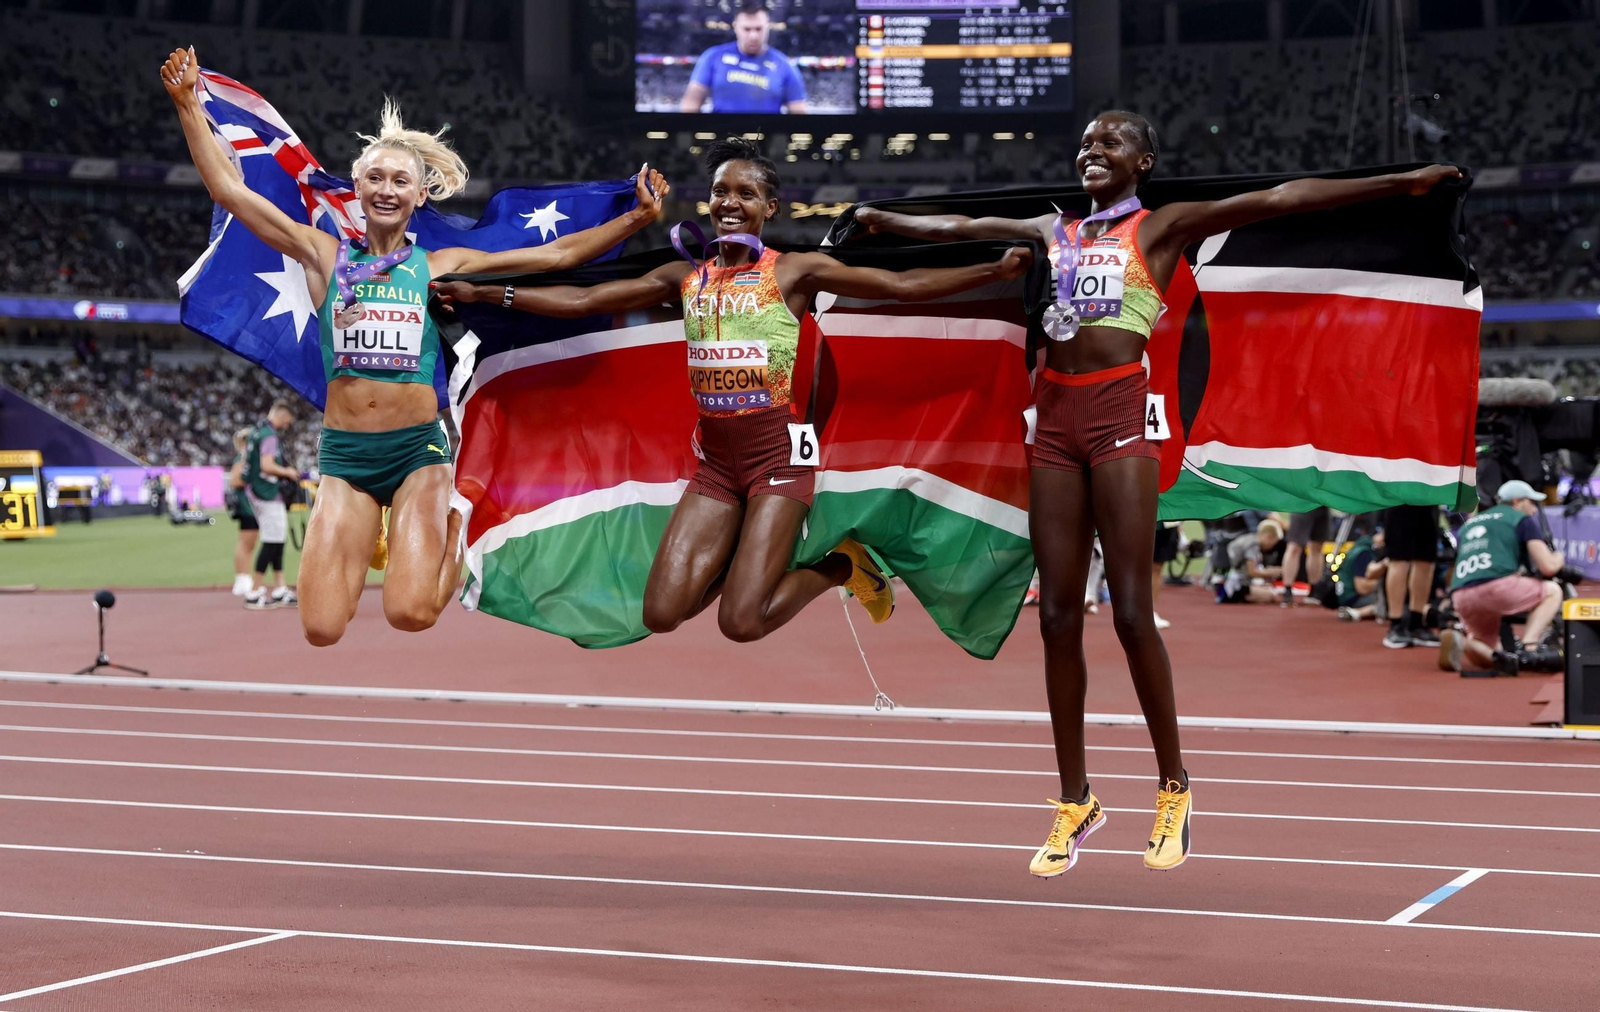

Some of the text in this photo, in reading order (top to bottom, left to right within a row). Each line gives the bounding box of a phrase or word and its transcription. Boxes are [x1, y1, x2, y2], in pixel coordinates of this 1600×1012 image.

[335, 285, 423, 306] ASTRALIA
[685, 293, 760, 318] KENYA
[334, 308, 422, 324] HNDA
[343, 329, 408, 351] HULL
[689, 347, 764, 360] HONDA
[690, 369, 764, 390] KIPYEGON
[1146, 402, 1160, 433] 4
[799, 430, 813, 460] 6
[1456, 552, 1493, 579] 003
[1069, 799, 1101, 840] NITRO
